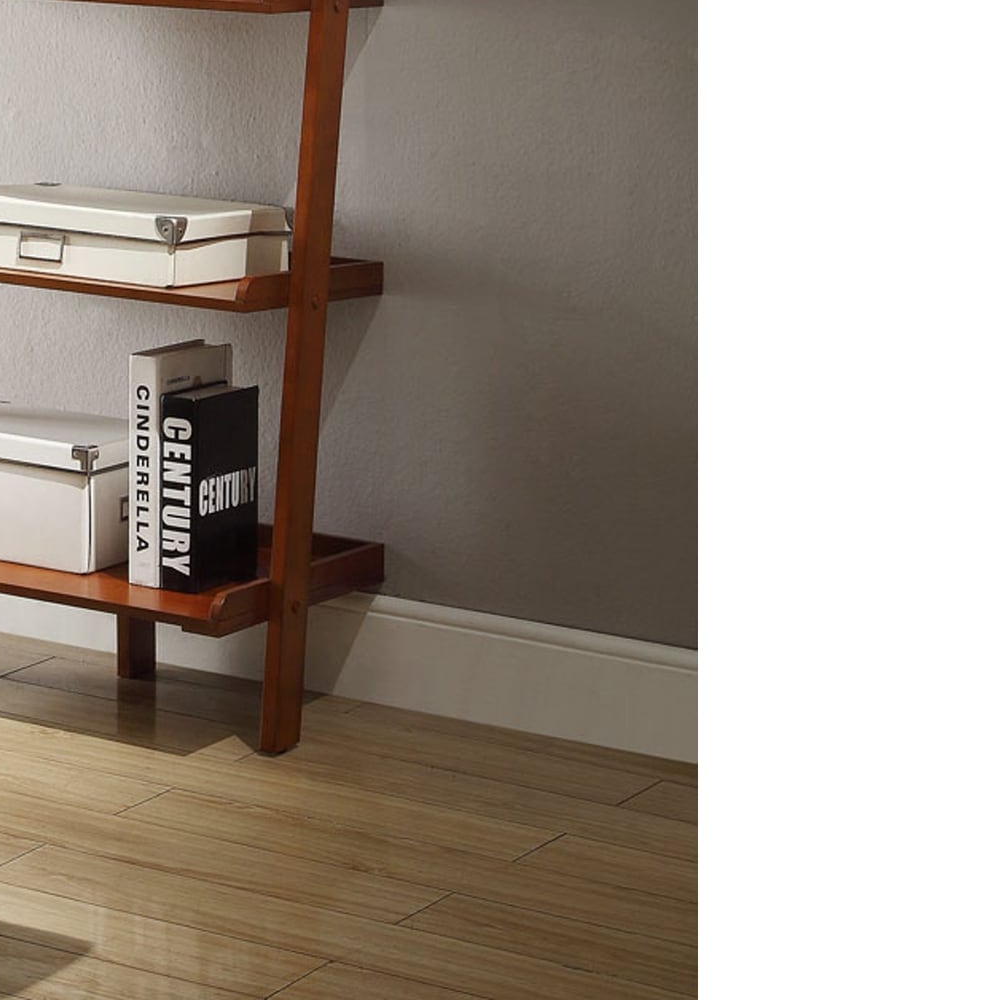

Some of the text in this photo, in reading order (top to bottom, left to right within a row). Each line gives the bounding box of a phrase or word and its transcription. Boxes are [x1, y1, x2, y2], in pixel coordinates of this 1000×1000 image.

[136, 385, 149, 552] CINDERELLA
[162, 417, 192, 576] CENTURY
[199, 466, 257, 517] CENTURY
